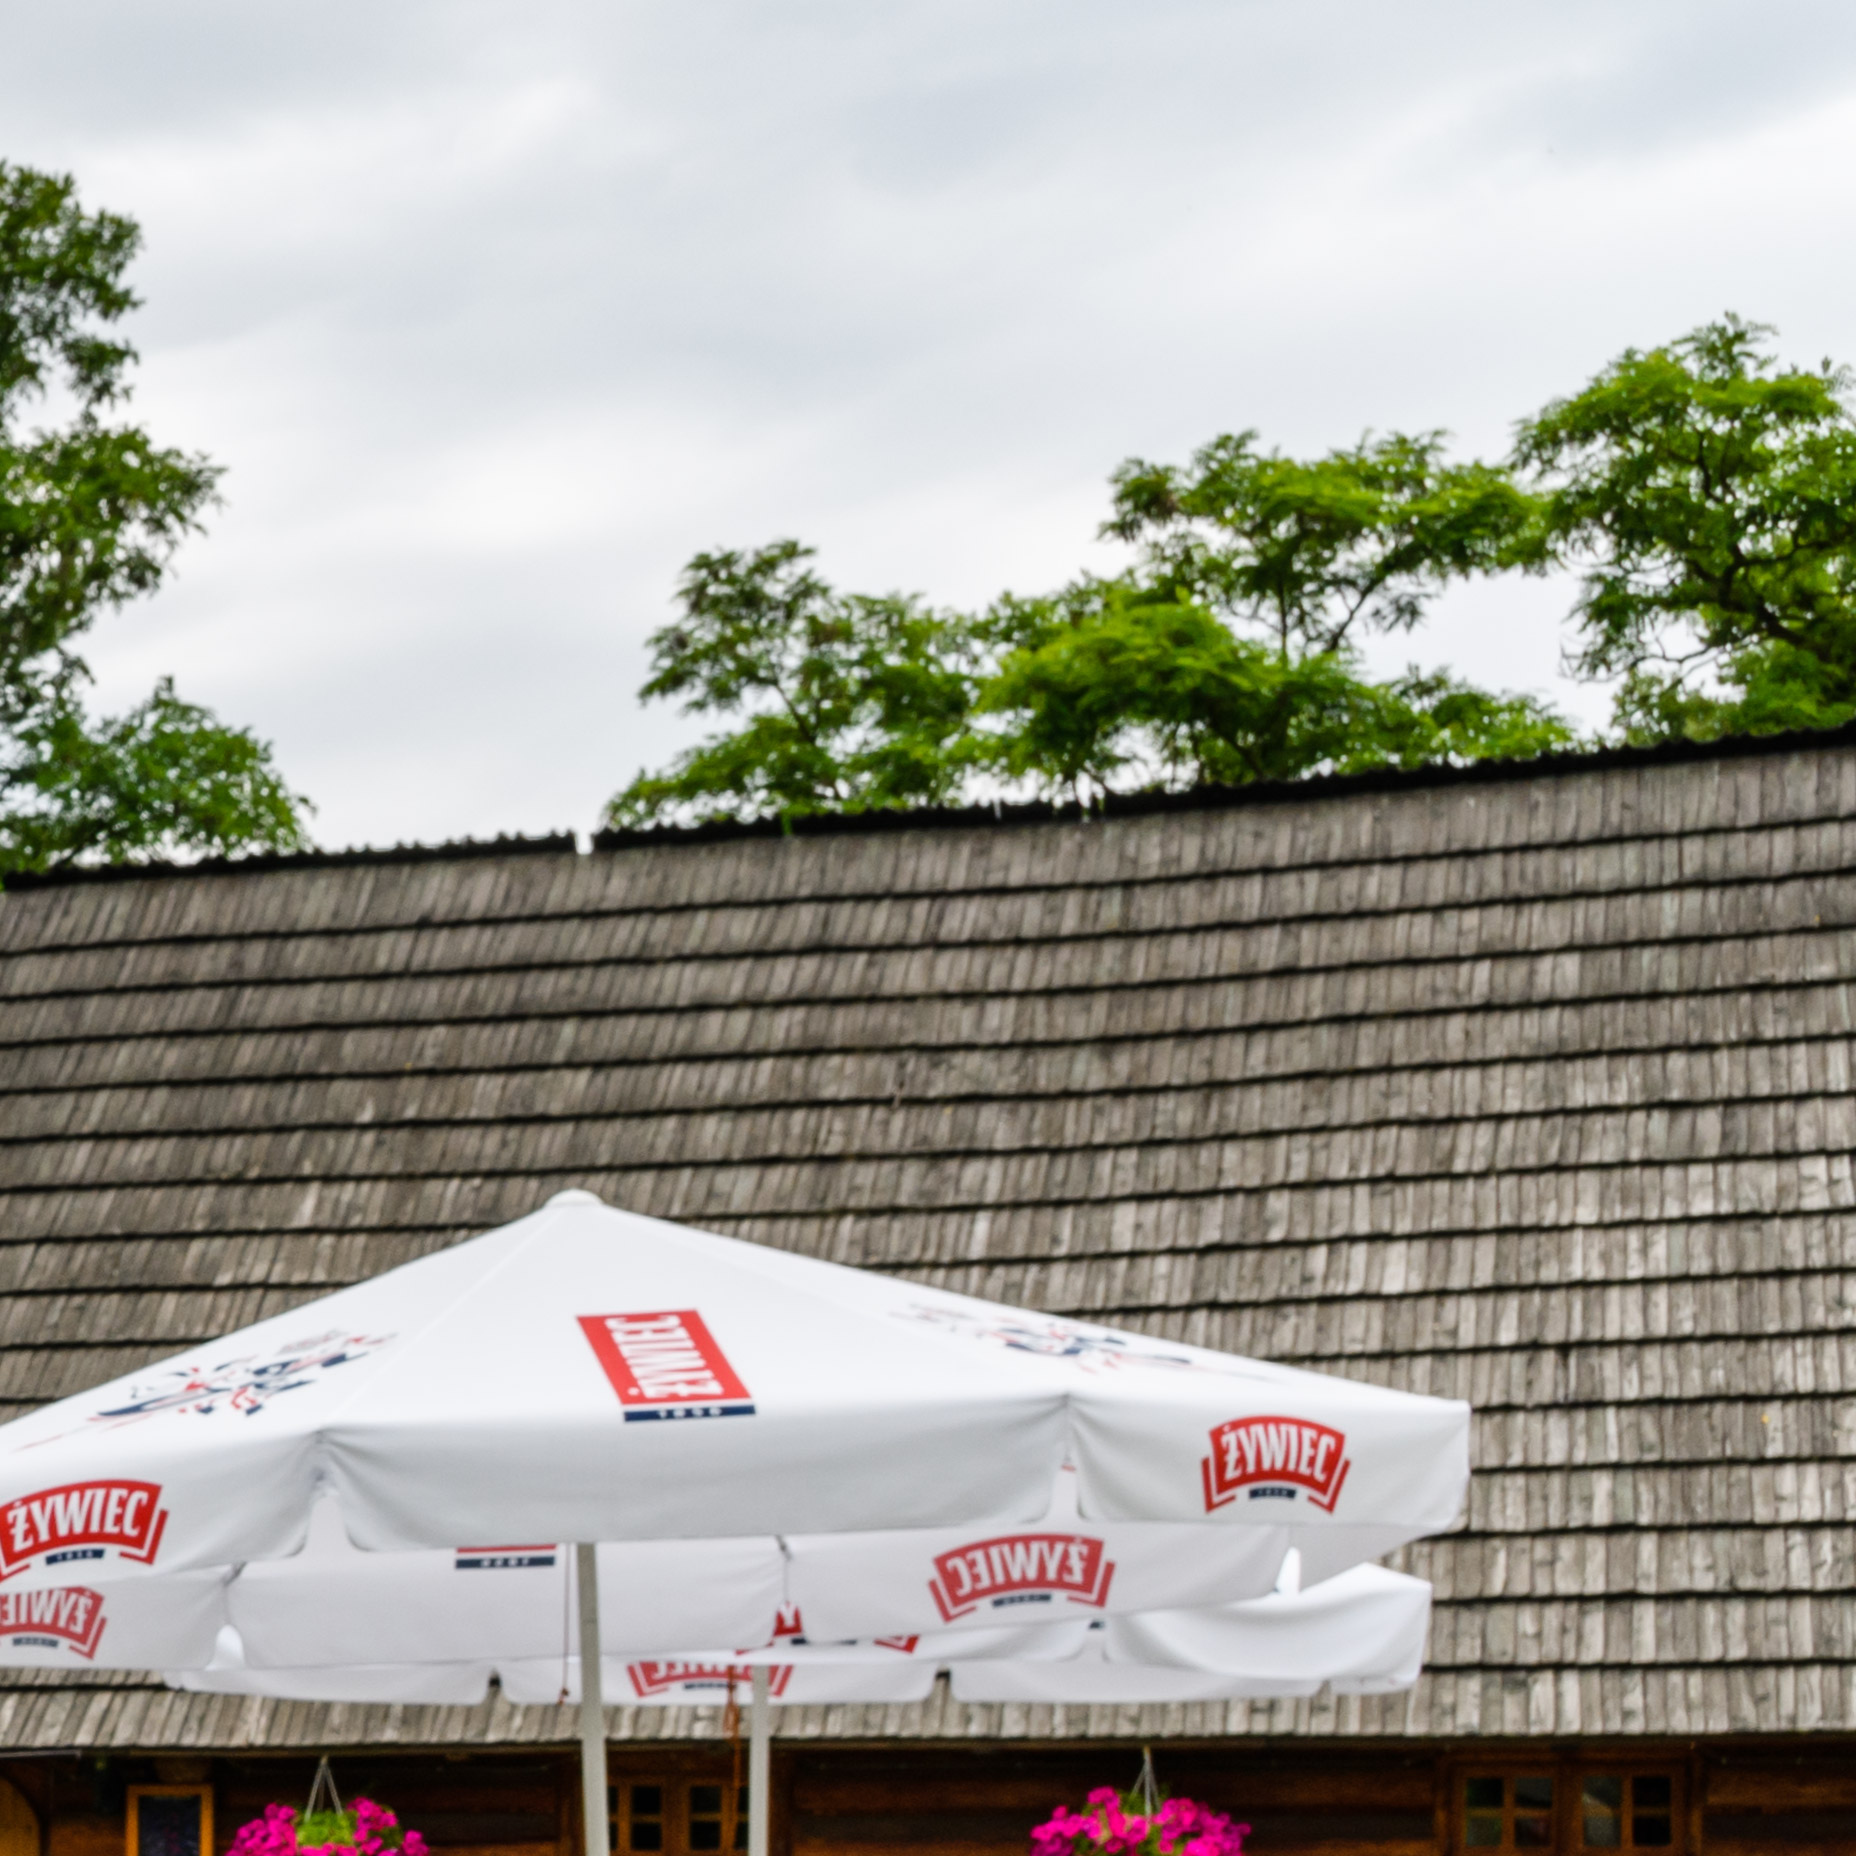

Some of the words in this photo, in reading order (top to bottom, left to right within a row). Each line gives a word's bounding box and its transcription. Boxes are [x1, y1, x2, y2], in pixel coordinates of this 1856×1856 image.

[604, 1315, 725, 1398] ŻYWIEC
[1221, 1423, 1336, 1482] ŻYWIEC
[7, 1488, 148, 1553] ŻYWIEC
